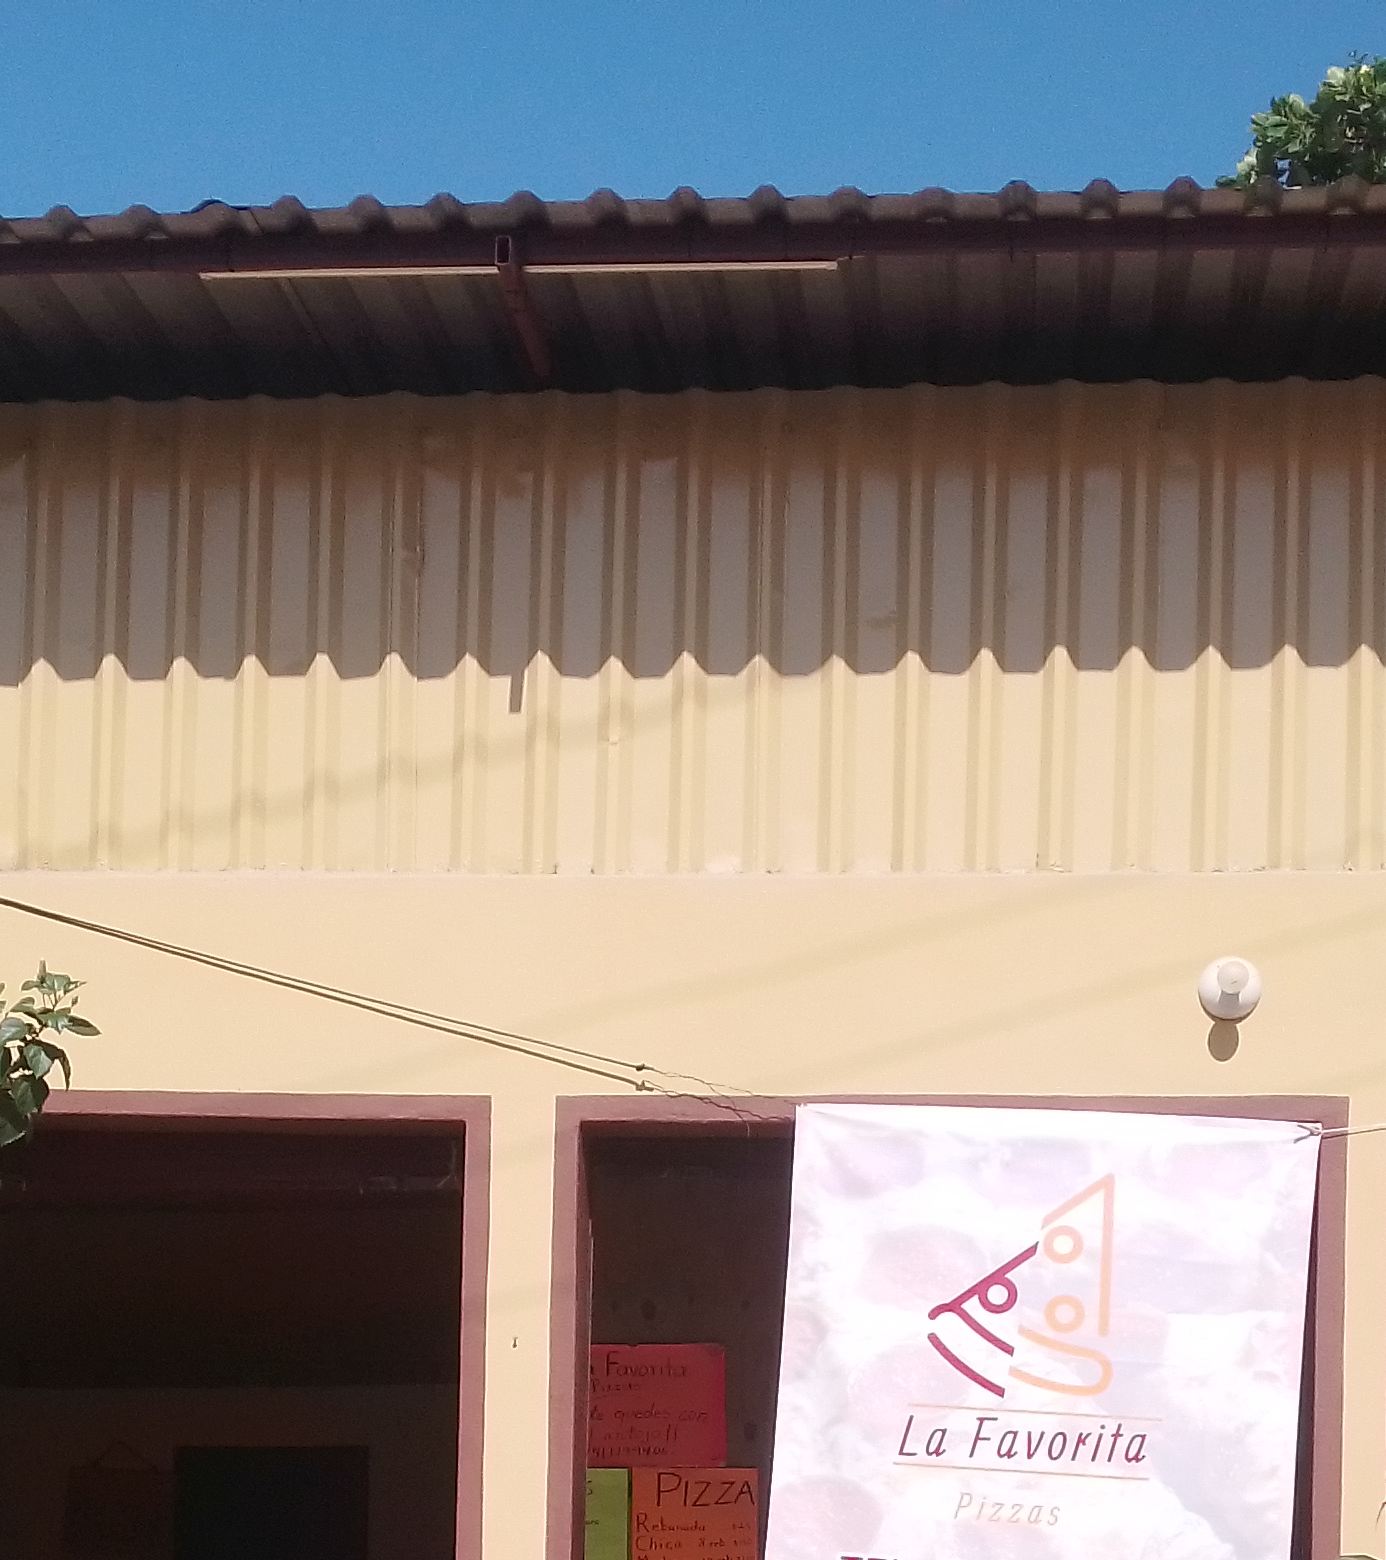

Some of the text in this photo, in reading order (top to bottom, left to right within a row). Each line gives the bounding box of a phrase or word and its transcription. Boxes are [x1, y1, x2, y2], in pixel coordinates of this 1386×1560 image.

[606, 1350, 688, 1377] Favorita
[897, 1413, 1148, 1465] La Favorita
[656, 1472, 756, 1508] PIZZA
[636, 1512, 706, 1533] Rebanada
[953, 1491, 1062, 1527] Pizzas
